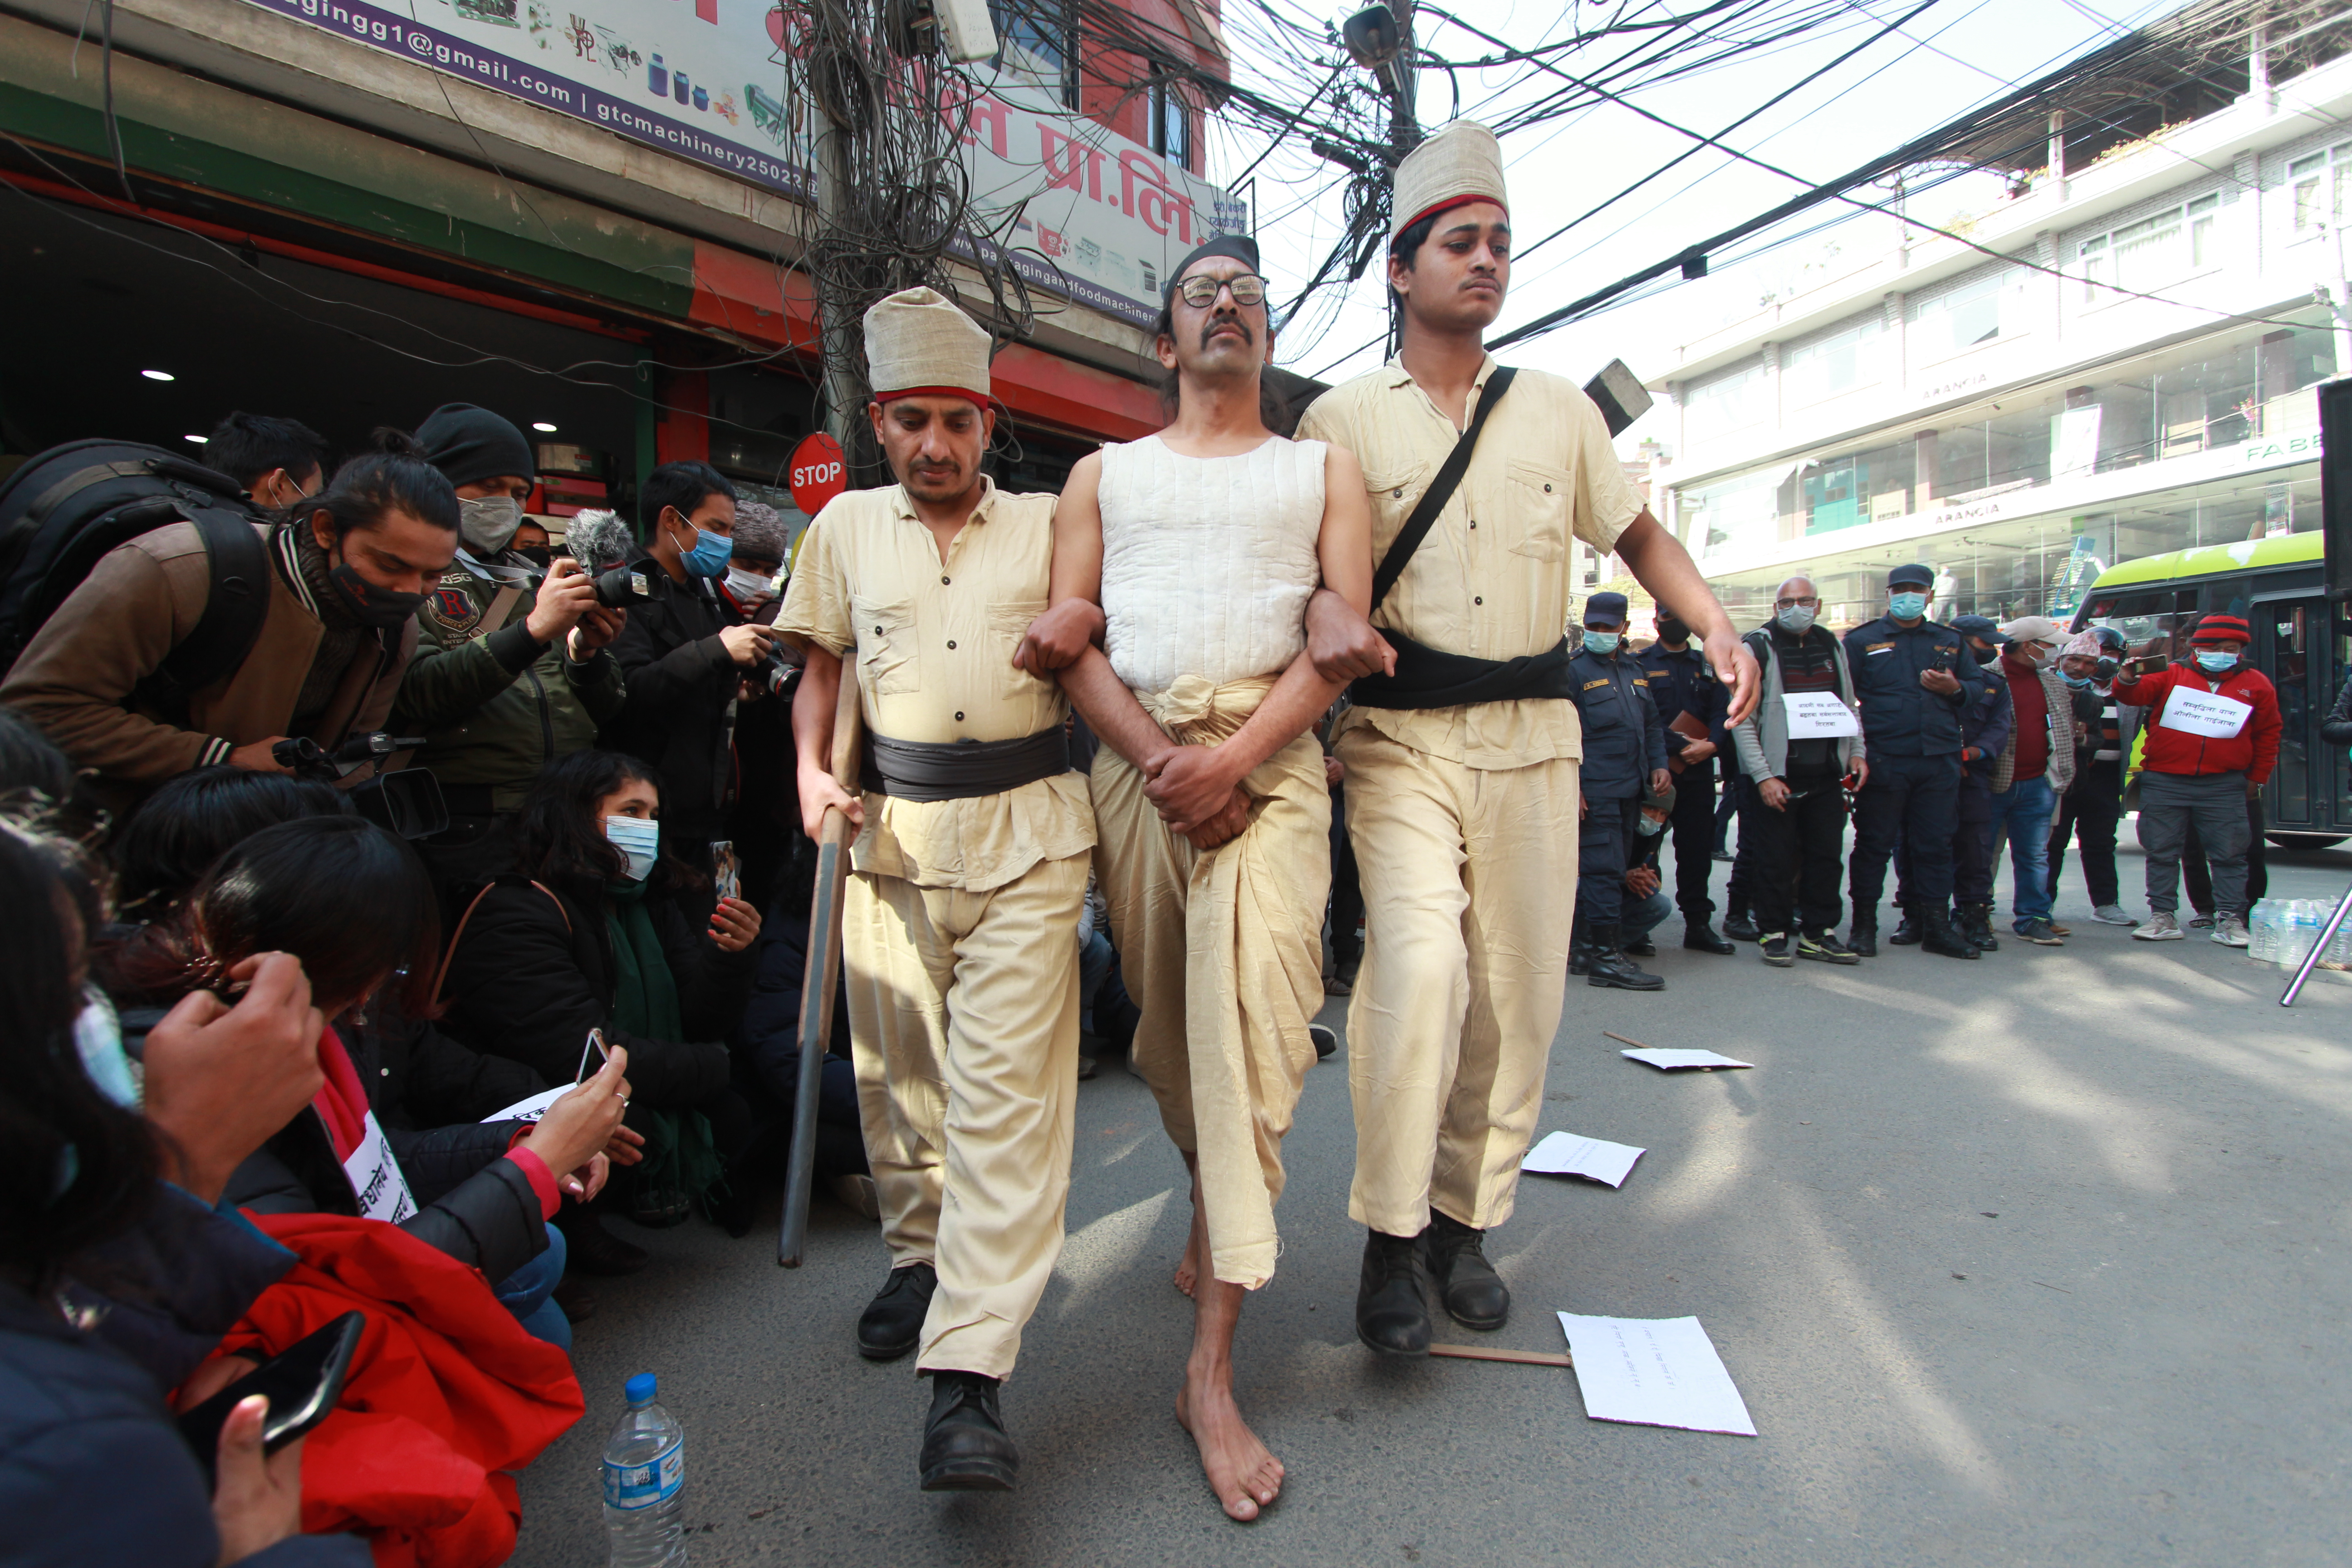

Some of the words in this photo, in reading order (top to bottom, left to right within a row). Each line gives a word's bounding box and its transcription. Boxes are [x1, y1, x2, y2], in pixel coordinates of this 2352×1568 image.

[1923, 373, 1987, 400] ARANCIA
[794, 461, 841, 487] STOP
[1935, 504, 1999, 525] ARANCIA
[436, 591, 467, 615] R
[462, 615, 476, 627] PLEIN
